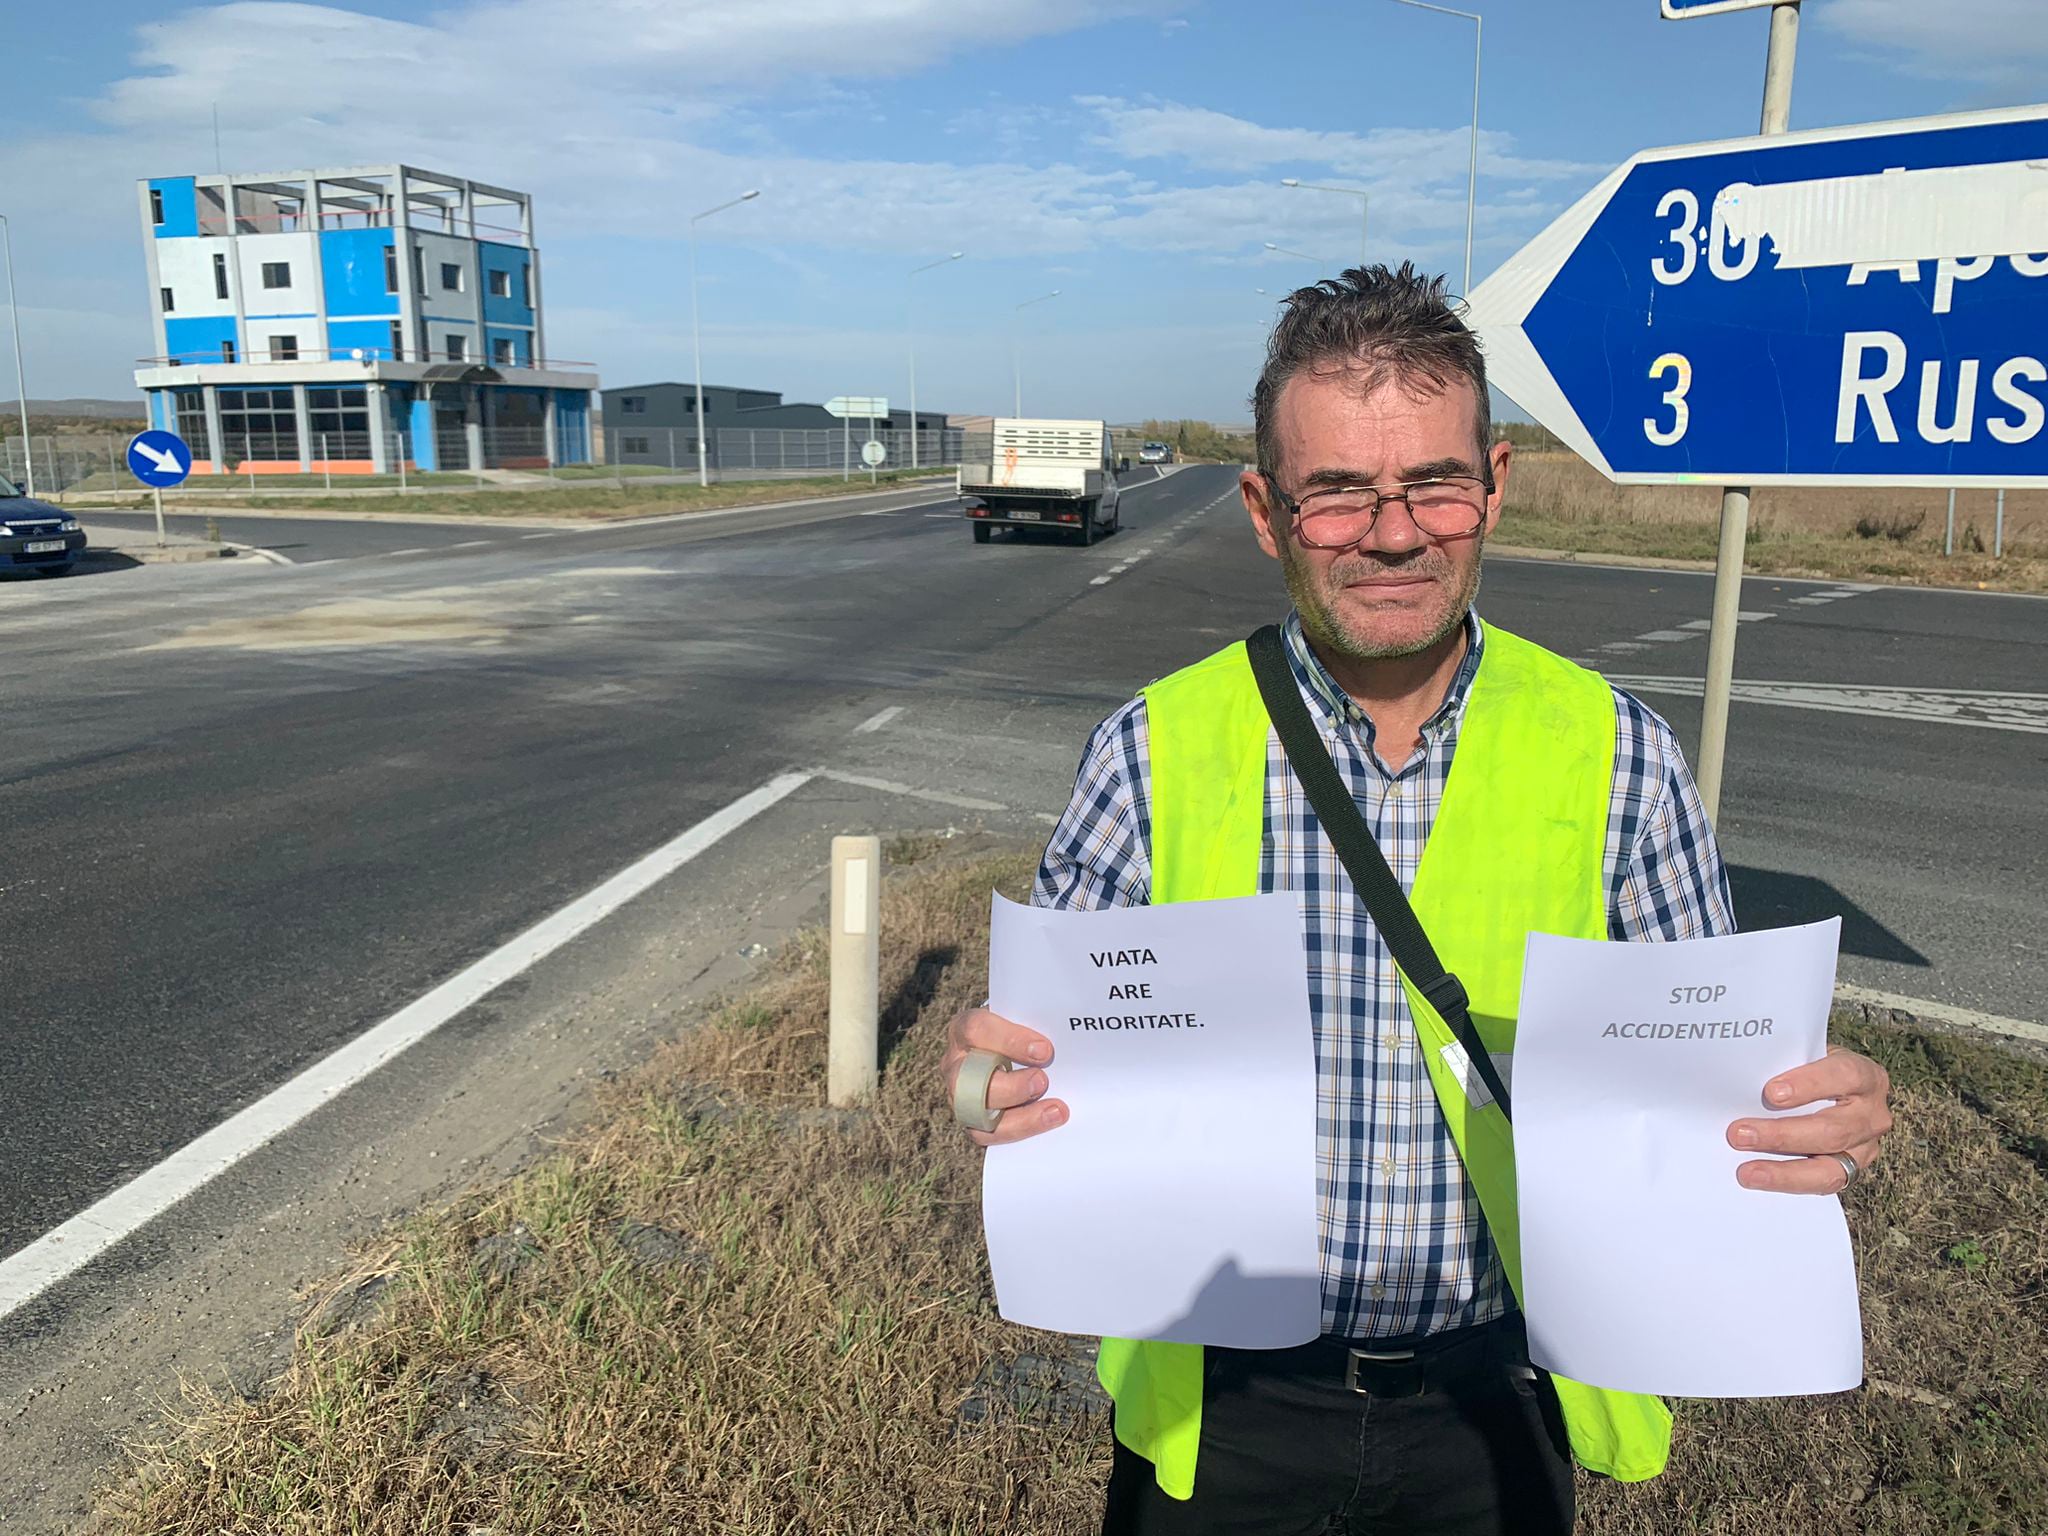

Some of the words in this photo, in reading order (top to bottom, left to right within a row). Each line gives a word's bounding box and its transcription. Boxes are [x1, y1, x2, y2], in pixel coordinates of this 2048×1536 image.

[1643, 352, 1692, 446] 3
[1089, 948, 1158, 968] VIATA
[1108, 983, 1153, 1000] ARE
[1669, 984, 1727, 1004] STOP
[1069, 1013, 1205, 1031] PRIORITATE.
[1601, 1018, 1773, 1039] ACCIDENTELOR
